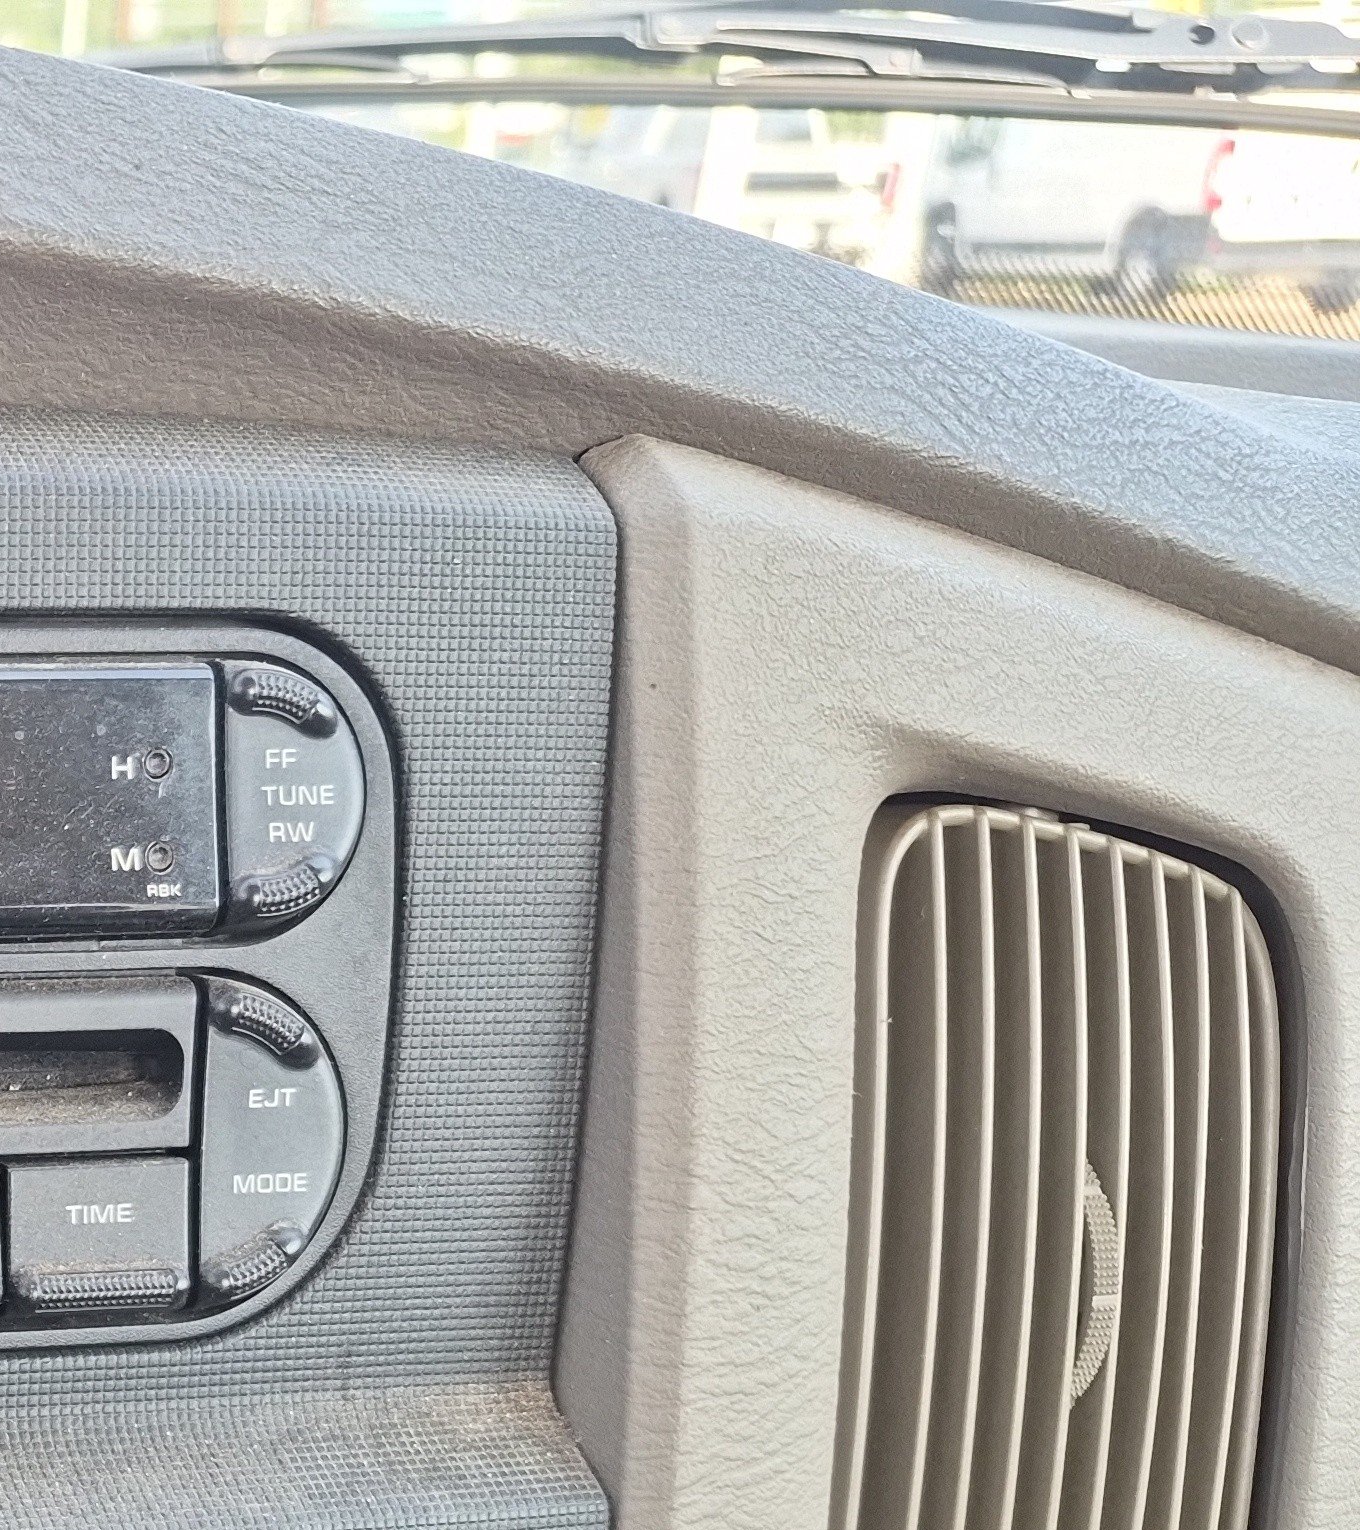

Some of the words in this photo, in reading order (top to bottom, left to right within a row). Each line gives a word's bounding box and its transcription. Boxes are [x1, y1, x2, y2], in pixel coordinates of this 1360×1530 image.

[111, 755, 135, 780] H
[265, 747, 298, 769] FF
[260, 783, 335, 806] TUNE
[268, 821, 315, 843] RW
[110, 848, 143, 872] M
[146, 883, 182, 898] RBK
[248, 1087, 298, 1109] EJT
[233, 1172, 309, 1194] MODE
[65, 1202, 136, 1225] TIME
